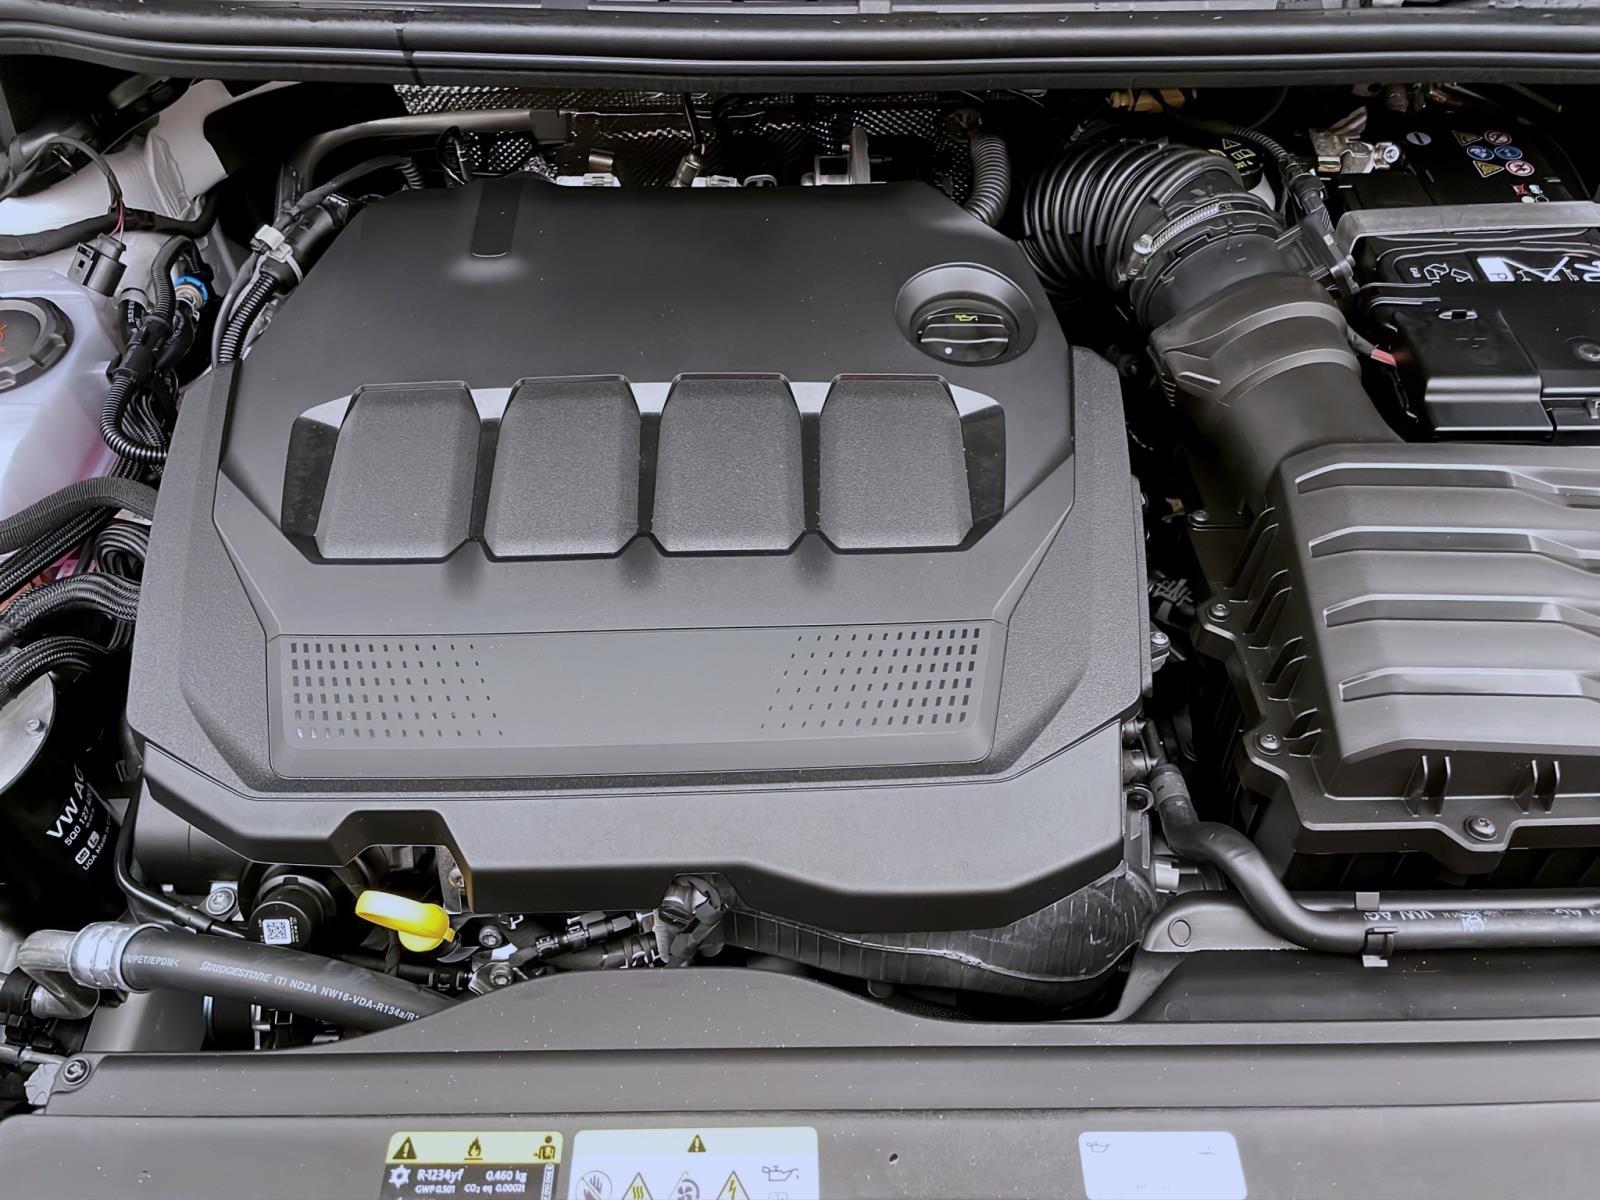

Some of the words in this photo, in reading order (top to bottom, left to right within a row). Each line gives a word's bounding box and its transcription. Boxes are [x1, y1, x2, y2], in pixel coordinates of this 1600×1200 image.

[46, 797, 79, 838] VW
[200, 961, 272, 983] BRIDGESTONE
[274, 975, 288, 986] (T)
[289, 979, 318, 994] ND2A
[416, 1168, 465, 1184] R-1234yf
[515, 1169, 528, 1184] kg
[415, 1184, 435, 1194] GWP
[482, 1185, 493, 1196] eq
